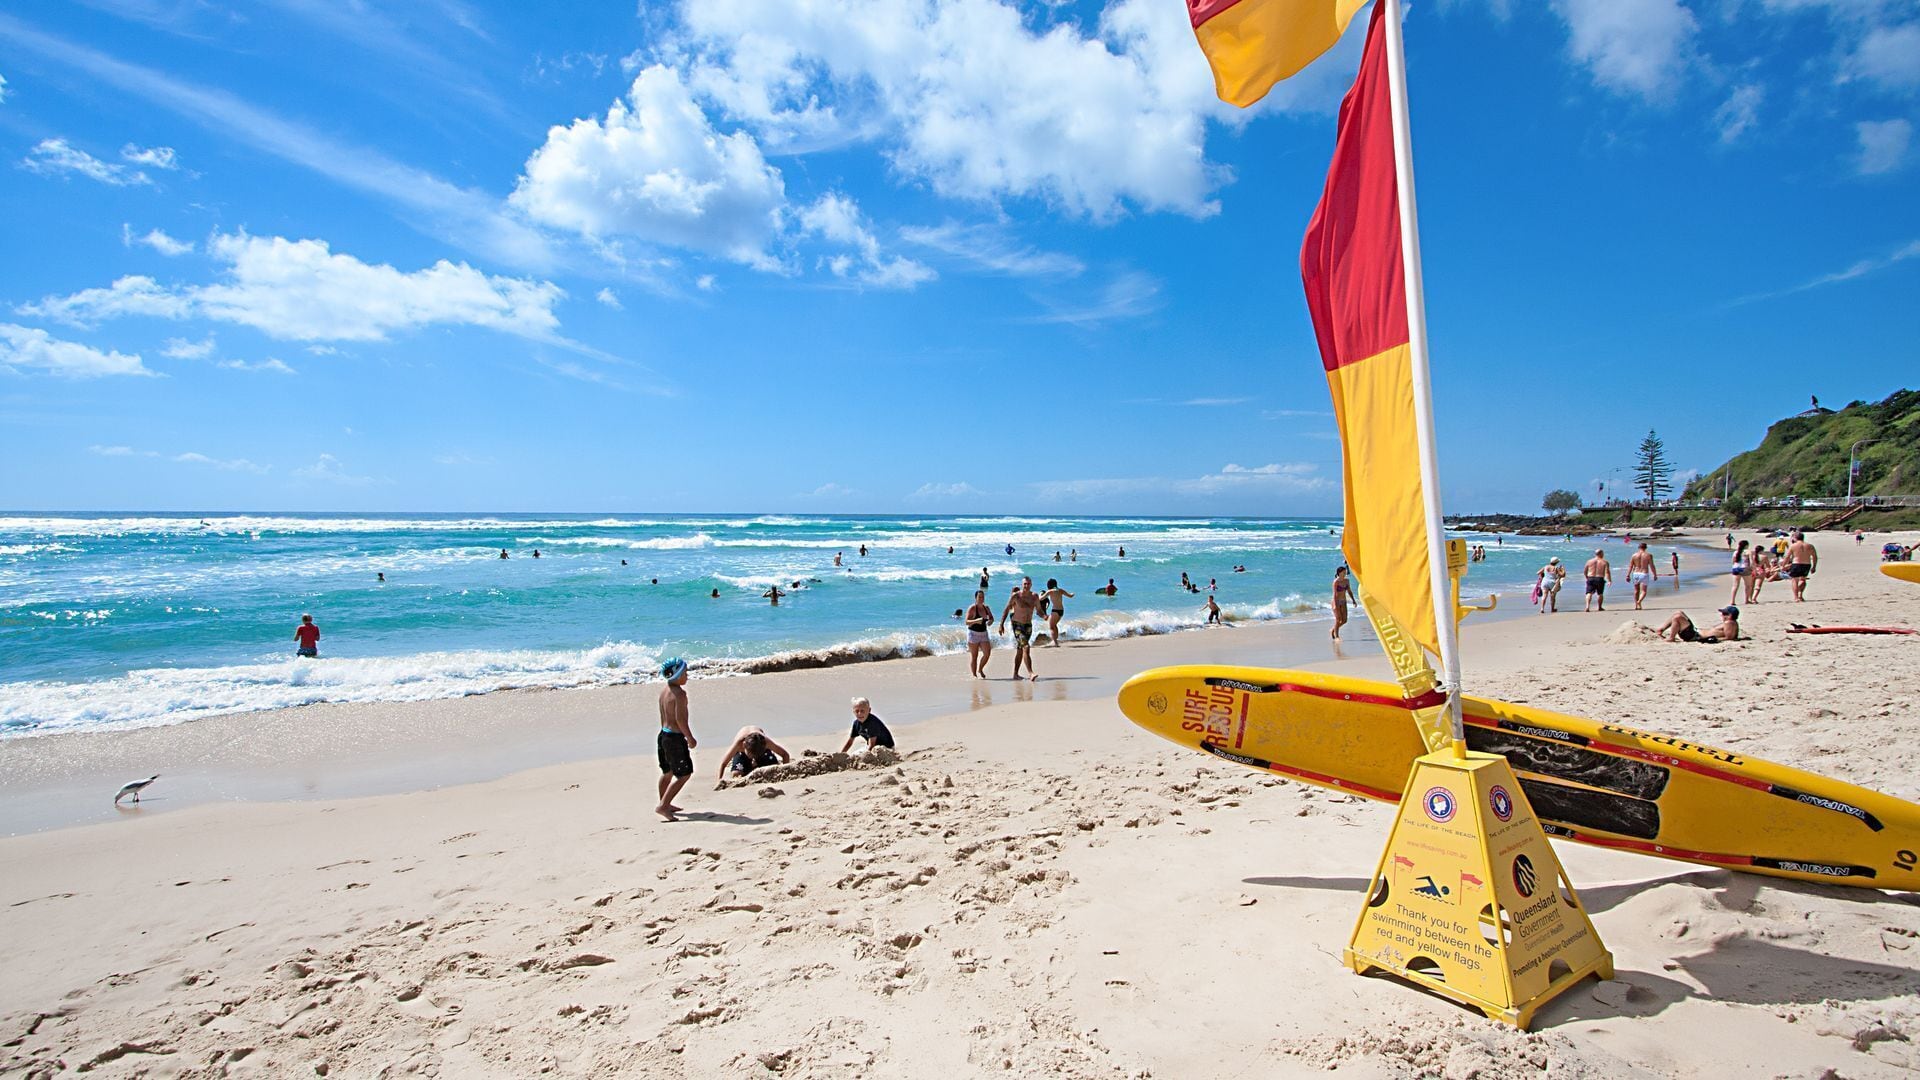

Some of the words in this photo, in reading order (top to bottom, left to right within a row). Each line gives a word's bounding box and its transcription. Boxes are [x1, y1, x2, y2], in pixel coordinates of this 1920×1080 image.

[1181, 688, 1209, 733] SURF
[1205, 685, 1235, 748] RESCUE
[1518, 726, 1570, 740] TAIPAN
[1214, 748, 1254, 764] TAIPAN
[1798, 793, 1866, 819] TAIPAN
[1404, 818, 1415, 826] THE
[1417, 821, 1430, 829] LIFE
[1779, 861, 1850, 876] TAIPAN
[1396, 903, 1427, 922] Thank
[1430, 916, 1450, 930] you
[1453, 921, 1468, 935] for
[1513, 890, 1557, 924] Queensland
[1519, 908, 1561, 938] Government
[1372, 912, 1422, 936] swimming
[1424, 927, 1471, 951] between
[1474, 943, 1492, 958] the
[1376, 927, 1393, 939] red
[1395, 933, 1415, 947] and
[1417, 941, 1451, 959] yellow
[1453, 951, 1484, 971] flags.
[1513, 958, 1539, 978] Promoting
[1541, 943, 1561, 961] healthier
[1561, 926, 1587, 949] Queensland
